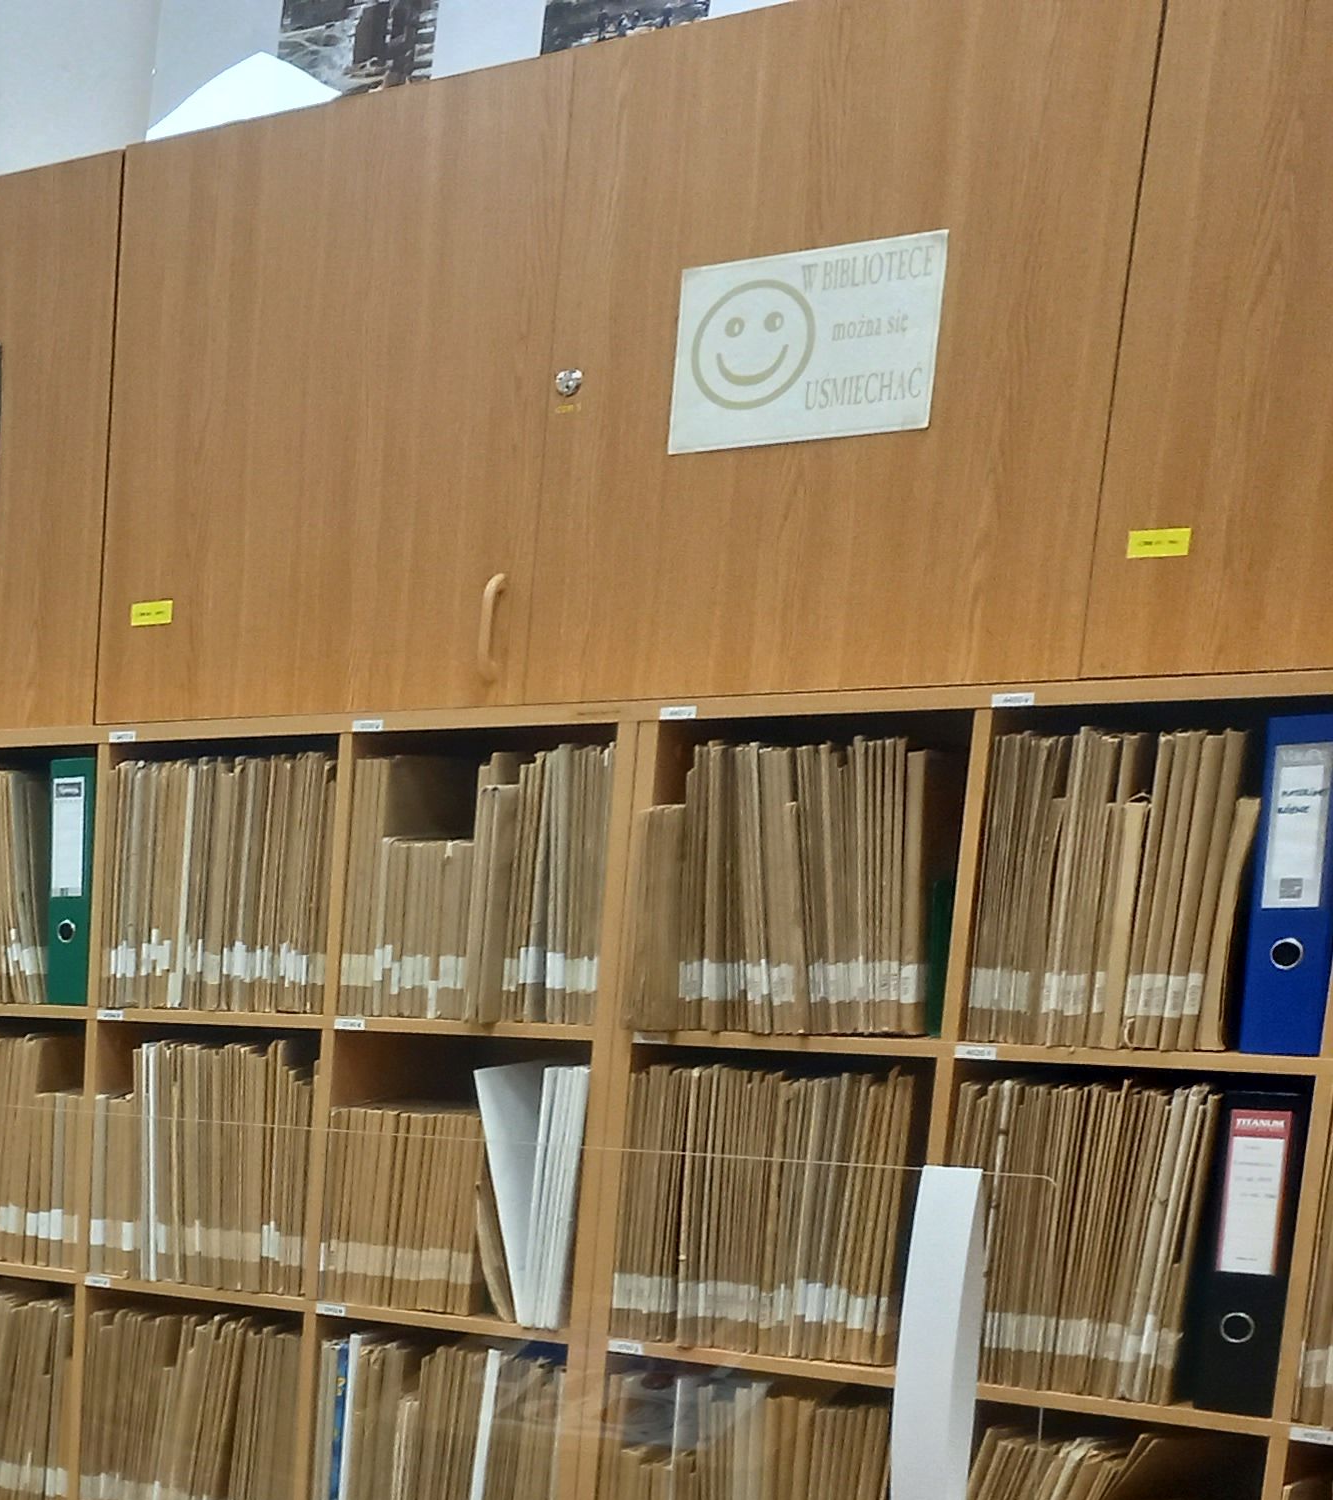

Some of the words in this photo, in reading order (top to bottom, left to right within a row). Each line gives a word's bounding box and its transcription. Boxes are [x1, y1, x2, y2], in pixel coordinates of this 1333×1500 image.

[801, 263, 818, 292] W
[822, 245, 935, 292] BIBLIOTECE
[832, 315, 882, 341] można
[887, 310, 909, 338] się
[805, 362, 923, 411] UŚMIECHAĆ
